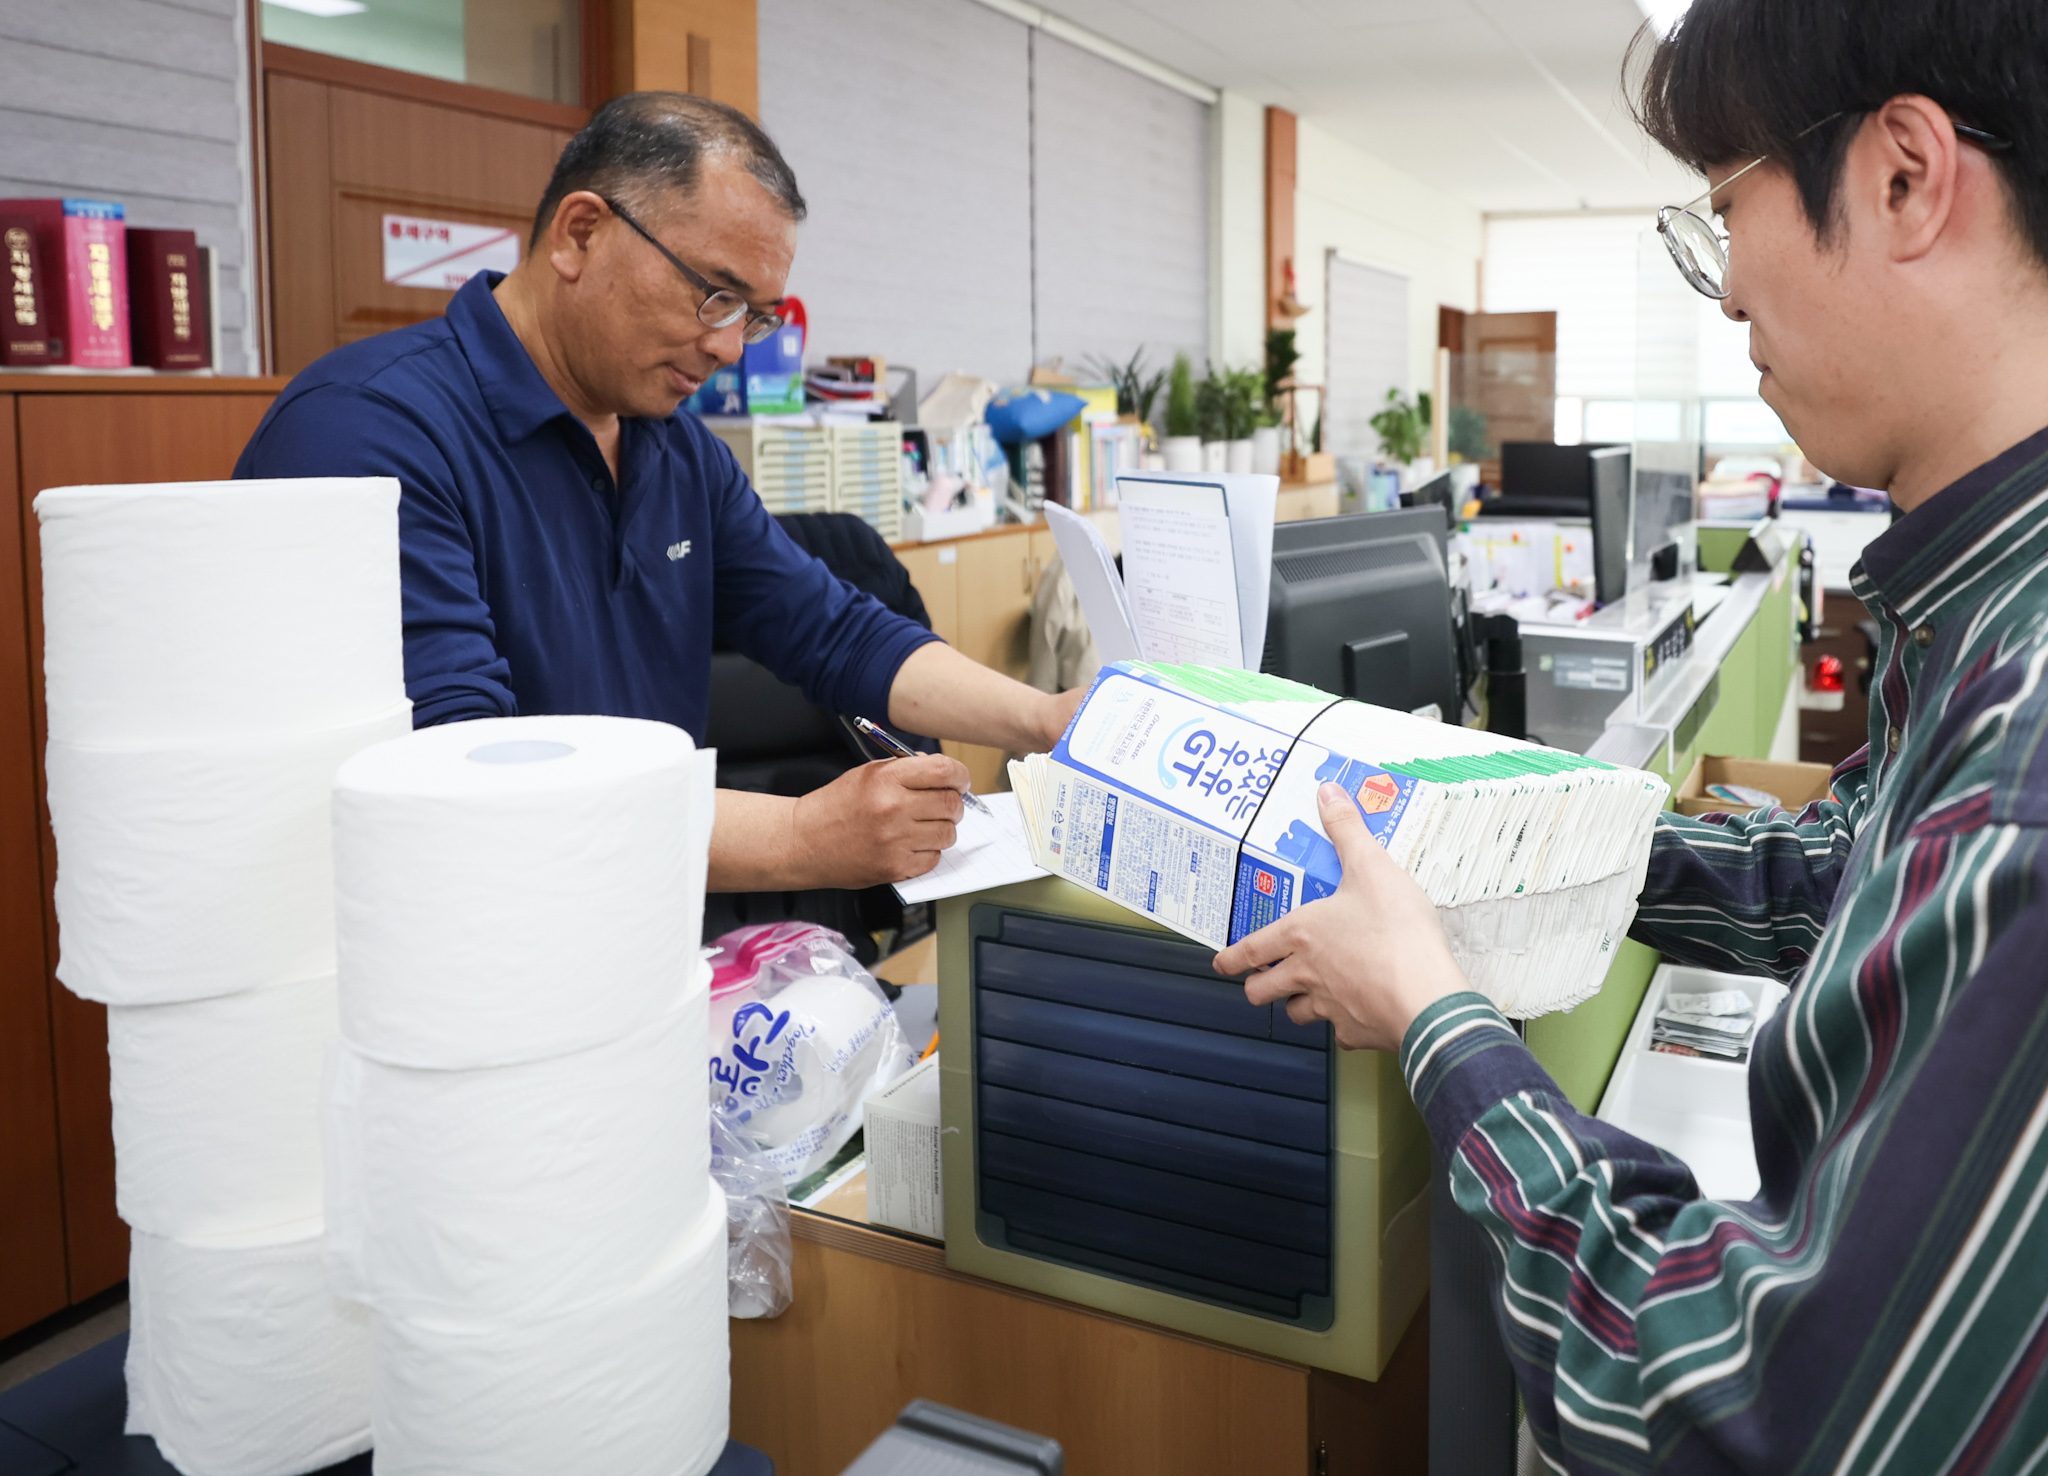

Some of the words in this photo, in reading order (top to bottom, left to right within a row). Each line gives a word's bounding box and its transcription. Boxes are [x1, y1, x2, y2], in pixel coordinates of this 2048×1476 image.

[390, 223, 450, 242] 통제구역
[1129, 698, 1154, 730] 대한민국
[1143, 714, 1159, 737] Great
[1110, 731, 1134, 765] 최고등급
[1130, 739, 1146, 760] Taste
[1172, 729, 1216, 787] GT
[1198, 740, 1249, 797] 우유
[1224, 747, 1288, 820] 맛있는
[1105, 796, 1117, 826] 영양정보
[1390, 798, 1406, 818] 맛있는
[775, 1022, 817, 1087] Together
